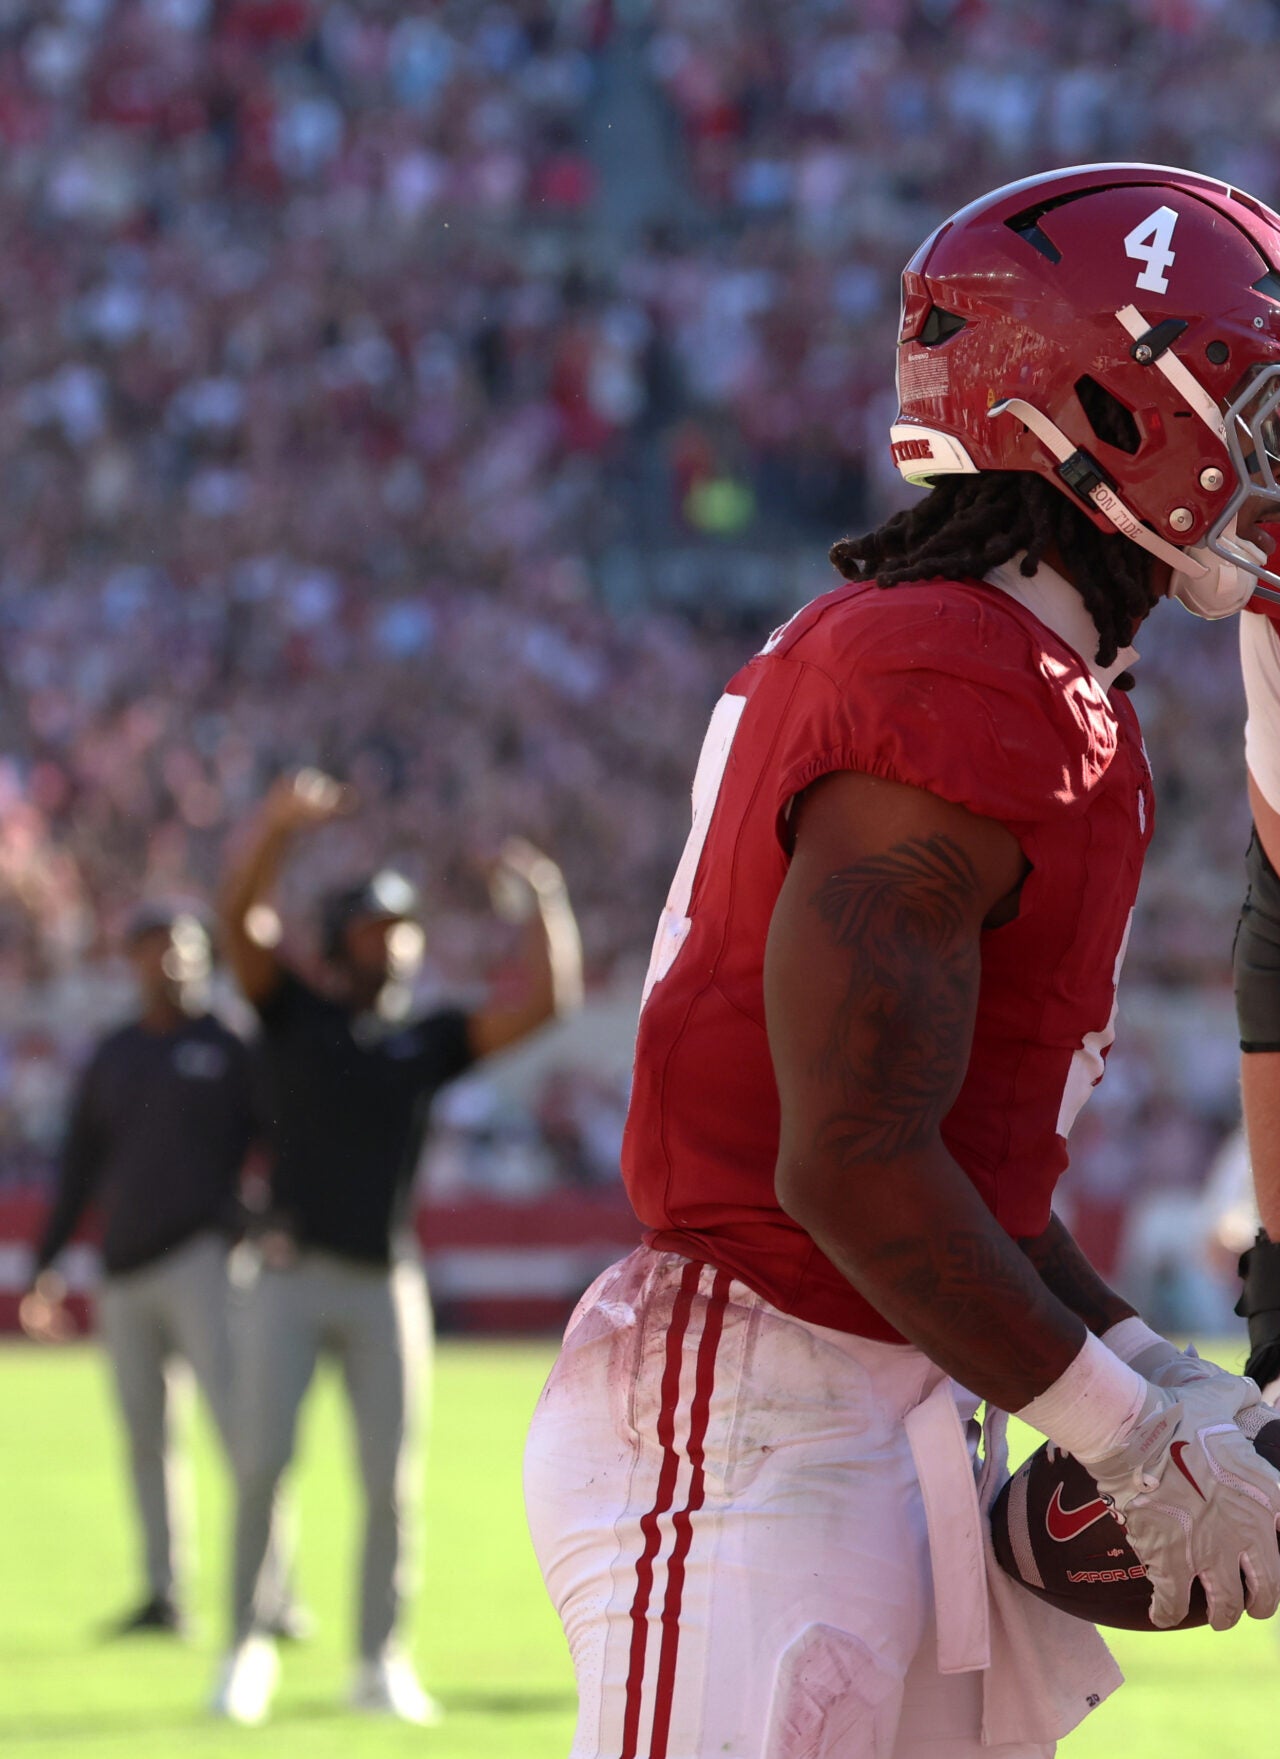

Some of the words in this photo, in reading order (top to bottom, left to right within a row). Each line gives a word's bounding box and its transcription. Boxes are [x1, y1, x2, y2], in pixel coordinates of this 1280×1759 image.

[1124, 205, 1179, 295] 4
[1090, 483, 1117, 511] SON
[1113, 510, 1143, 539] TIDE
[1066, 1569, 1129, 1583] VAPOR
